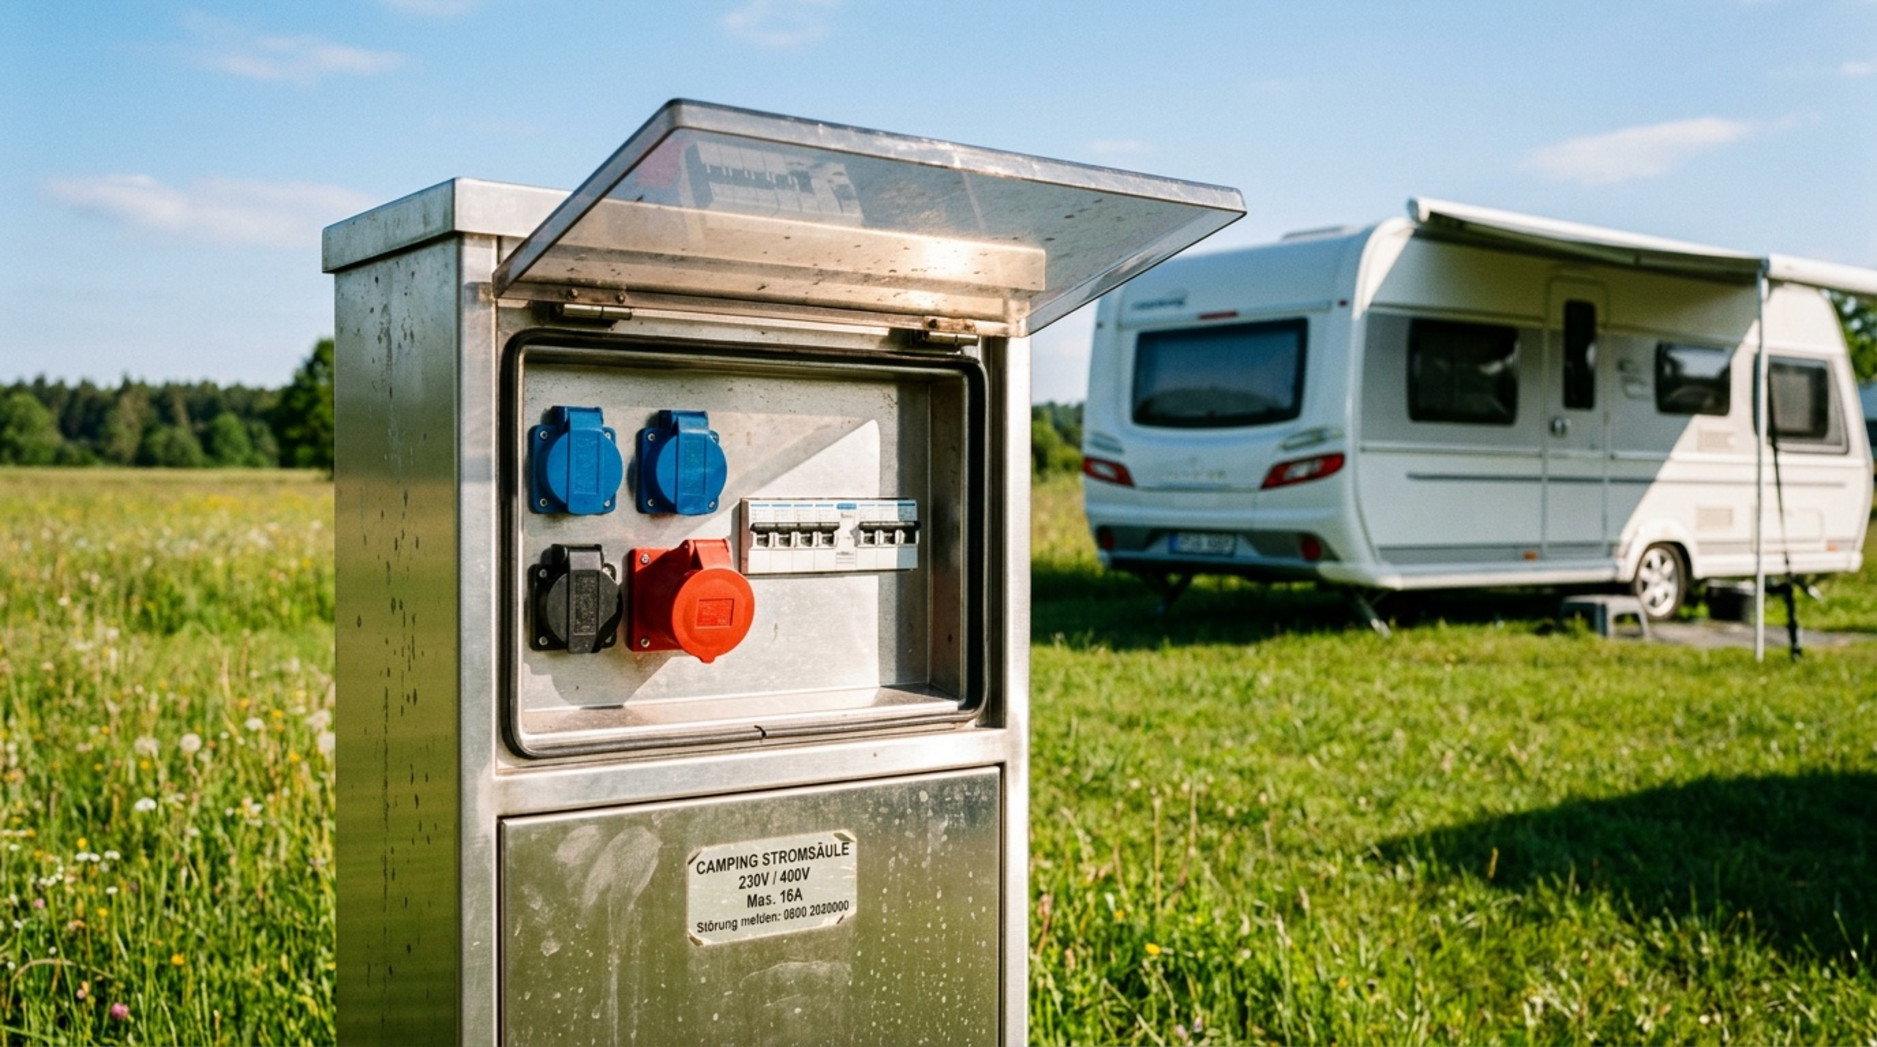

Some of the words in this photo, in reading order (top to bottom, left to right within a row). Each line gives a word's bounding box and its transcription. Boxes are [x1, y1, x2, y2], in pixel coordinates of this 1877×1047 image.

[696, 854, 758, 875] CAMPING
[762, 841, 850, 866] STROMSÄULE
[738, 872, 770, 890] 230V
[772, 871, 777, 885] /
[779, 867, 811, 884] 400V
[780, 887, 803, 903] 16A
[697, 918, 738, 934] Störung
[783, 907, 807, 921] 0800
